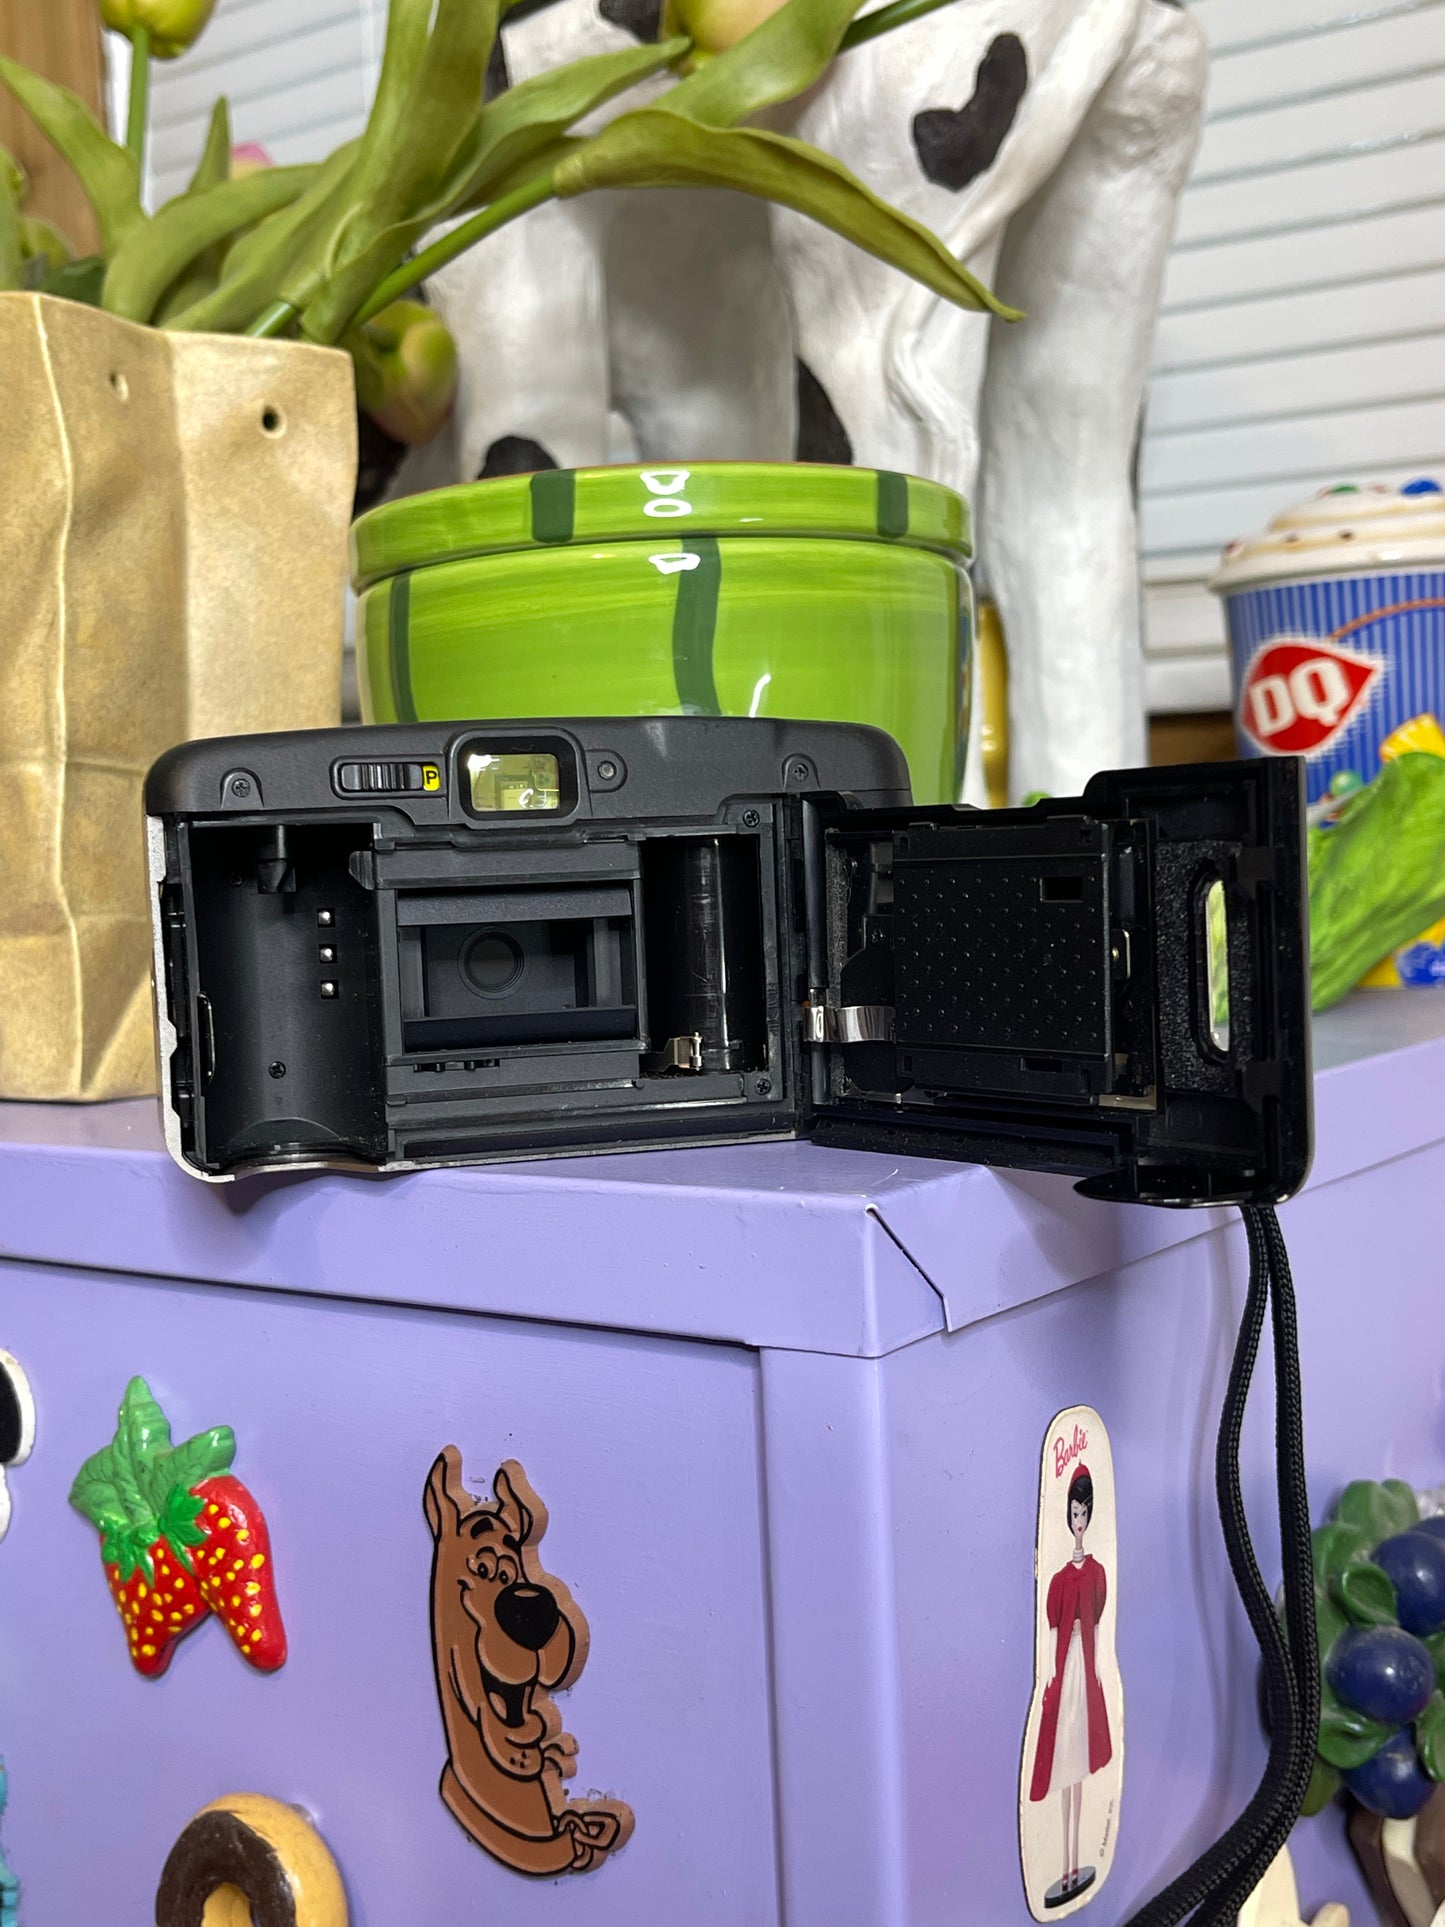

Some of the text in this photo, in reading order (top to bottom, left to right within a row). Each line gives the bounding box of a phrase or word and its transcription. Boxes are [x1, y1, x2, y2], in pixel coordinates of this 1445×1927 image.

[1250, 658, 1348, 736] DQ
[425, 770, 437, 784] P
[1053, 1424, 1088, 1478] Barbie
